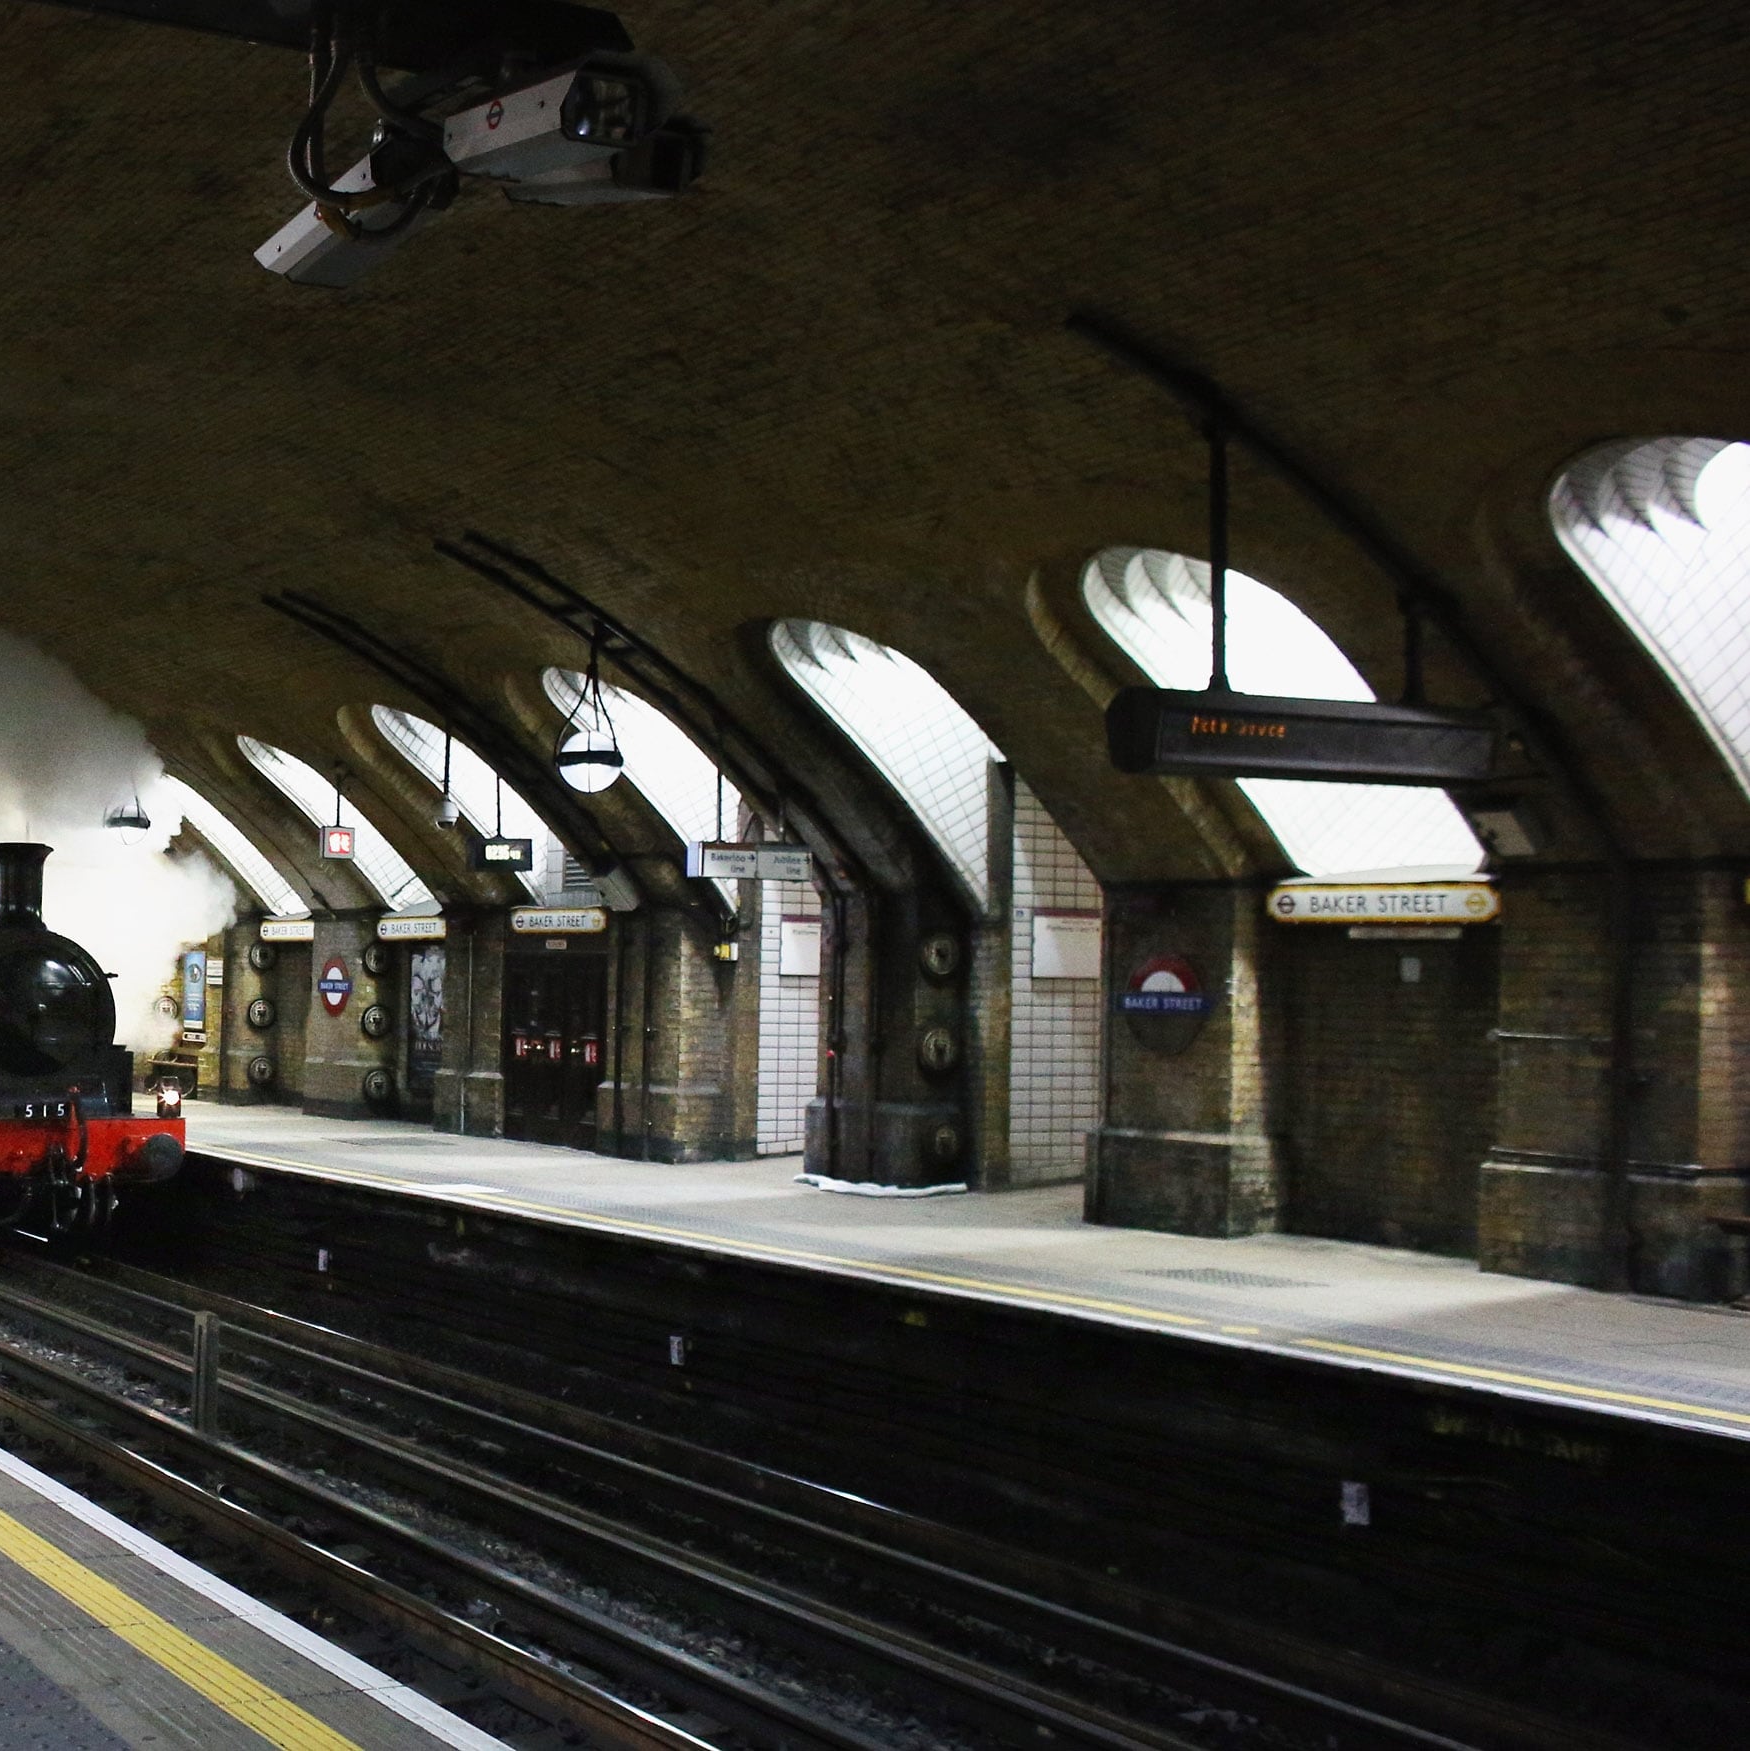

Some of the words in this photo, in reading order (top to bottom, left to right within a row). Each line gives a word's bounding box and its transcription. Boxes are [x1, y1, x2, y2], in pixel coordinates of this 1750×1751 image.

[1310, 896, 1369, 913] BAKER
[1378, 894, 1448, 913] STREET
[529, 915, 554, 927] BAKER
[557, 914, 587, 928] STREET
[391, 923, 411, 935] BAKER
[413, 922, 437, 934] STREET
[1125, 997, 1158, 1009] BAKER
[1163, 997, 1203, 1010] STREET
[25, 1103, 65, 1118] 515
